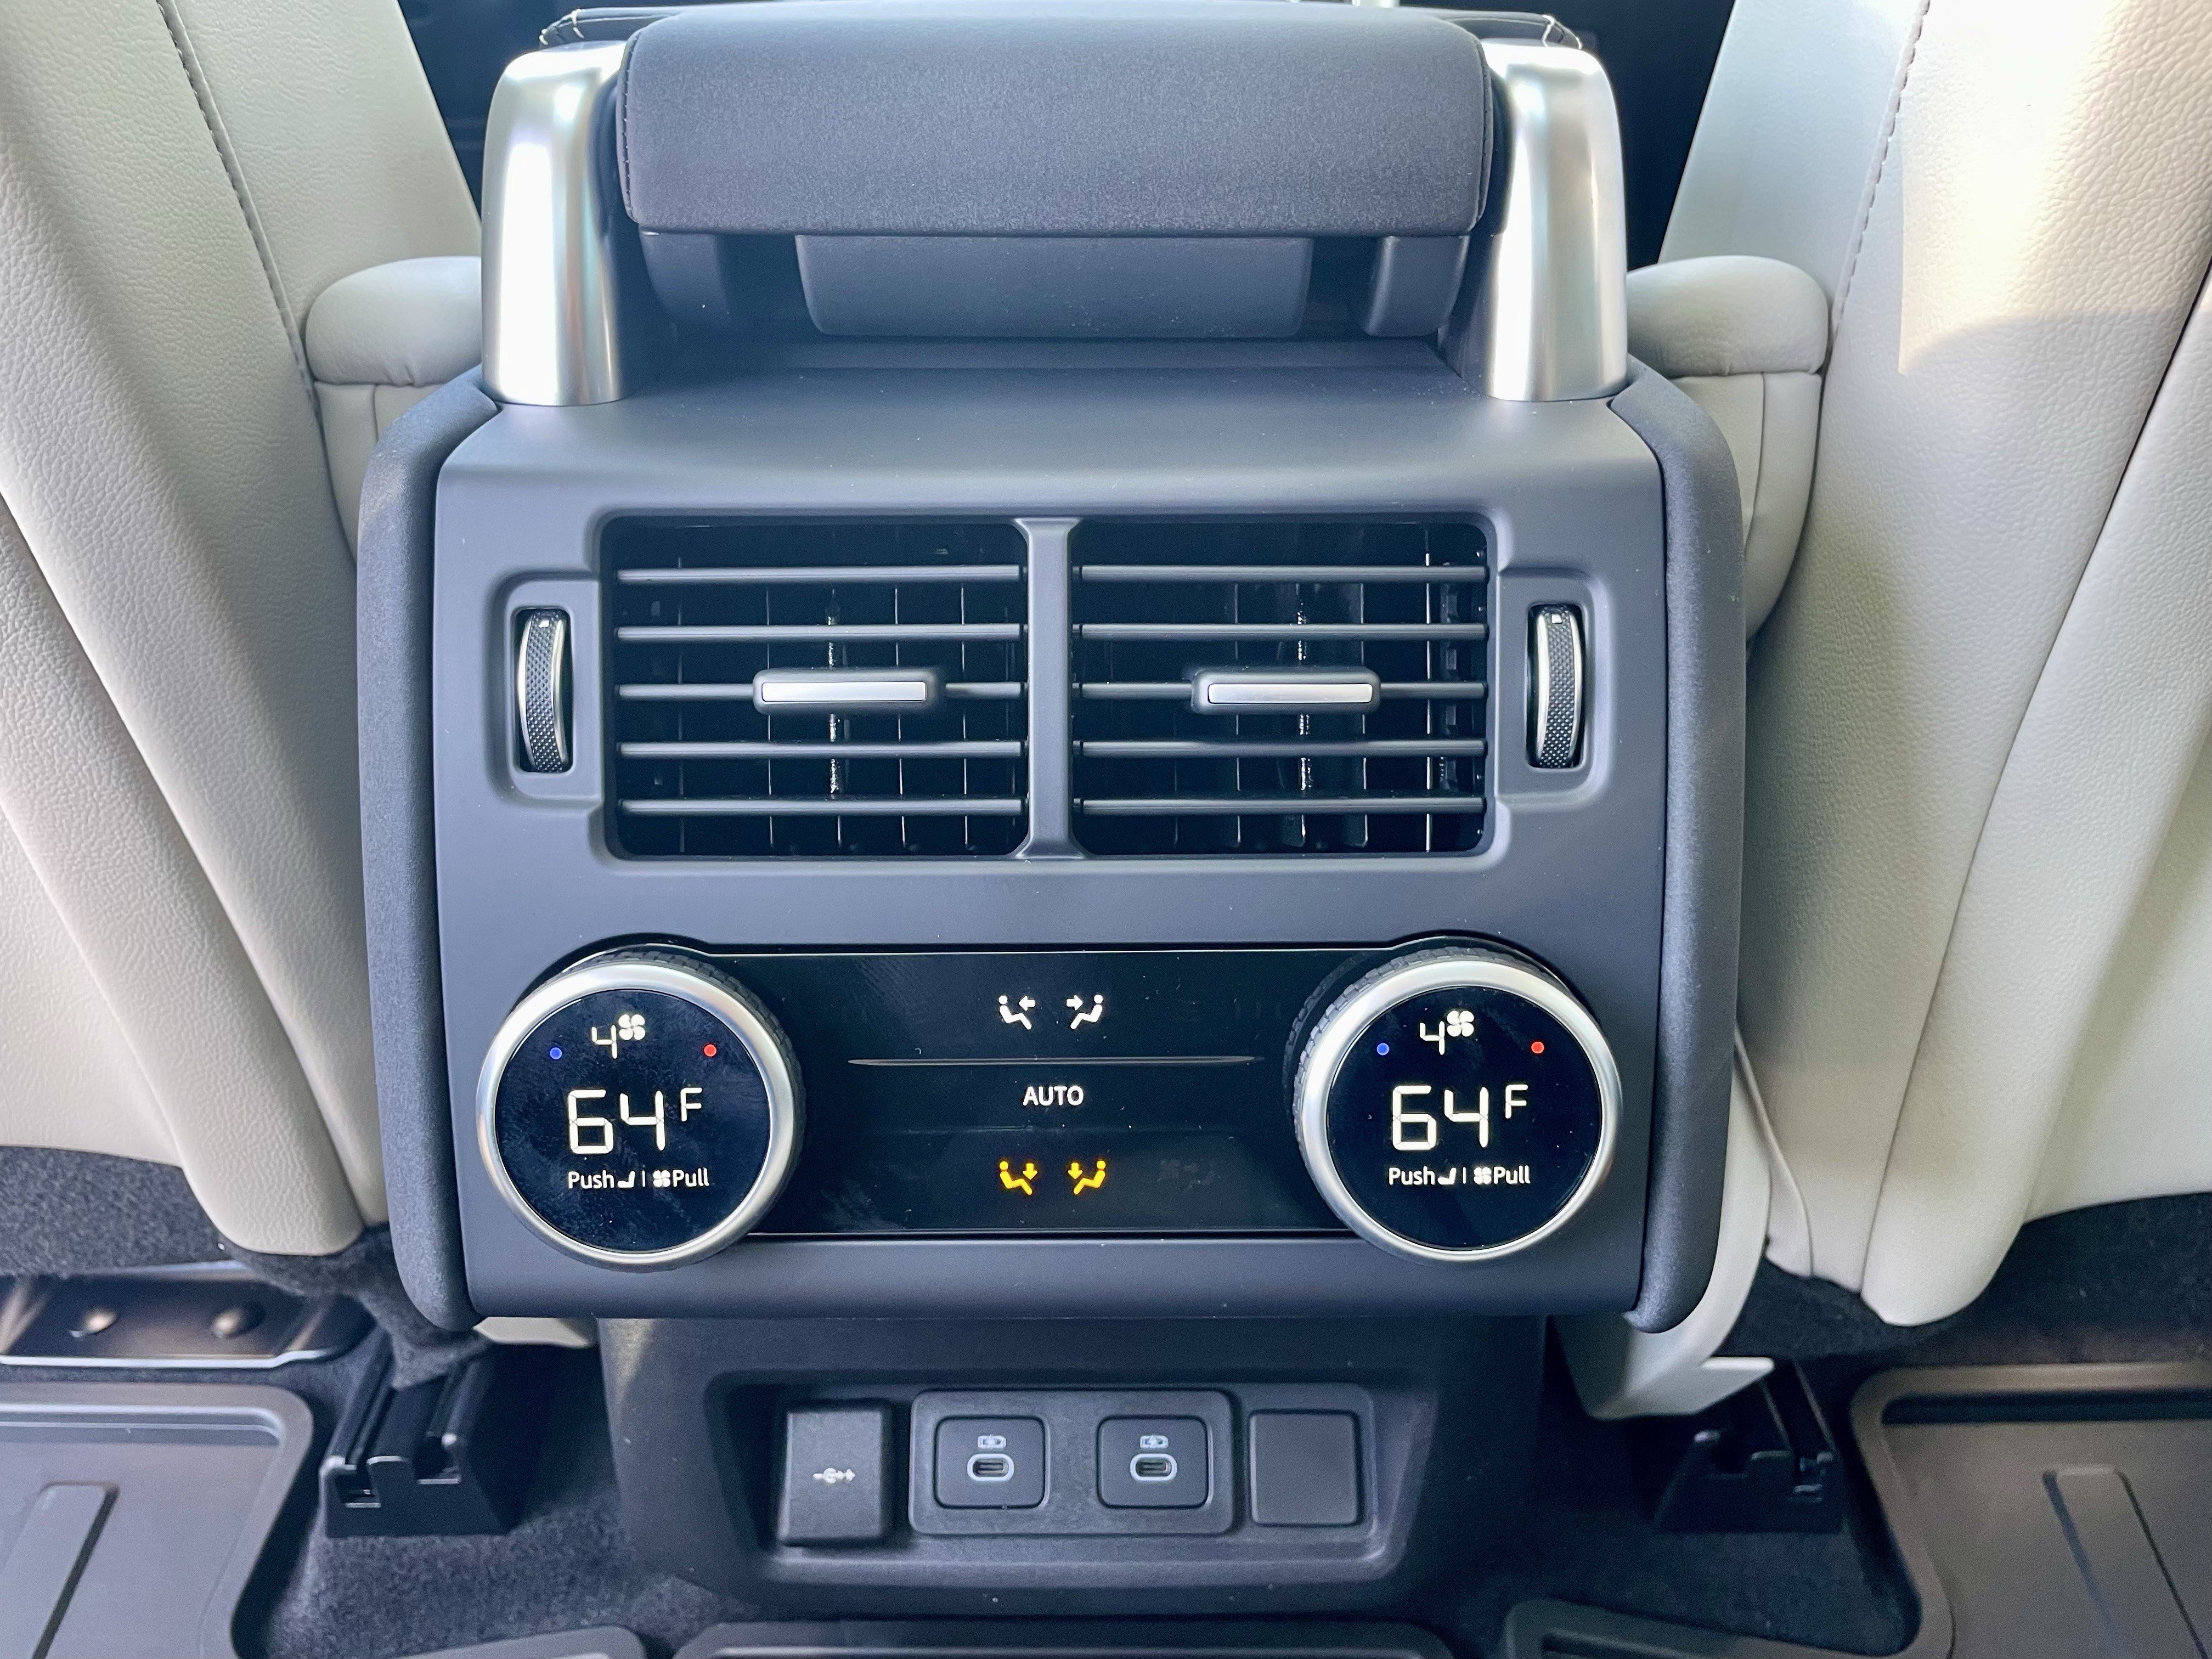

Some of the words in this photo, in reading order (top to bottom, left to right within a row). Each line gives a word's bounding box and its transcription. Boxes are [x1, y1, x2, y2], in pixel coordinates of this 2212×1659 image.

[591, 1024, 618, 1059] 4
[1419, 1020, 1446, 1056] 4
[1023, 1086, 1084, 1106] AUTO
[567, 1089, 665, 1154] 64
[680, 1087, 703, 1122] F
[1392, 1085, 1489, 1151] 64
[1505, 1084, 1528, 1119] F
[568, 1170, 615, 1189] Push
[672, 1167, 710, 1187] Pull
[1389, 1166, 1436, 1186] Push
[1493, 1165, 1531, 1184] Pull
